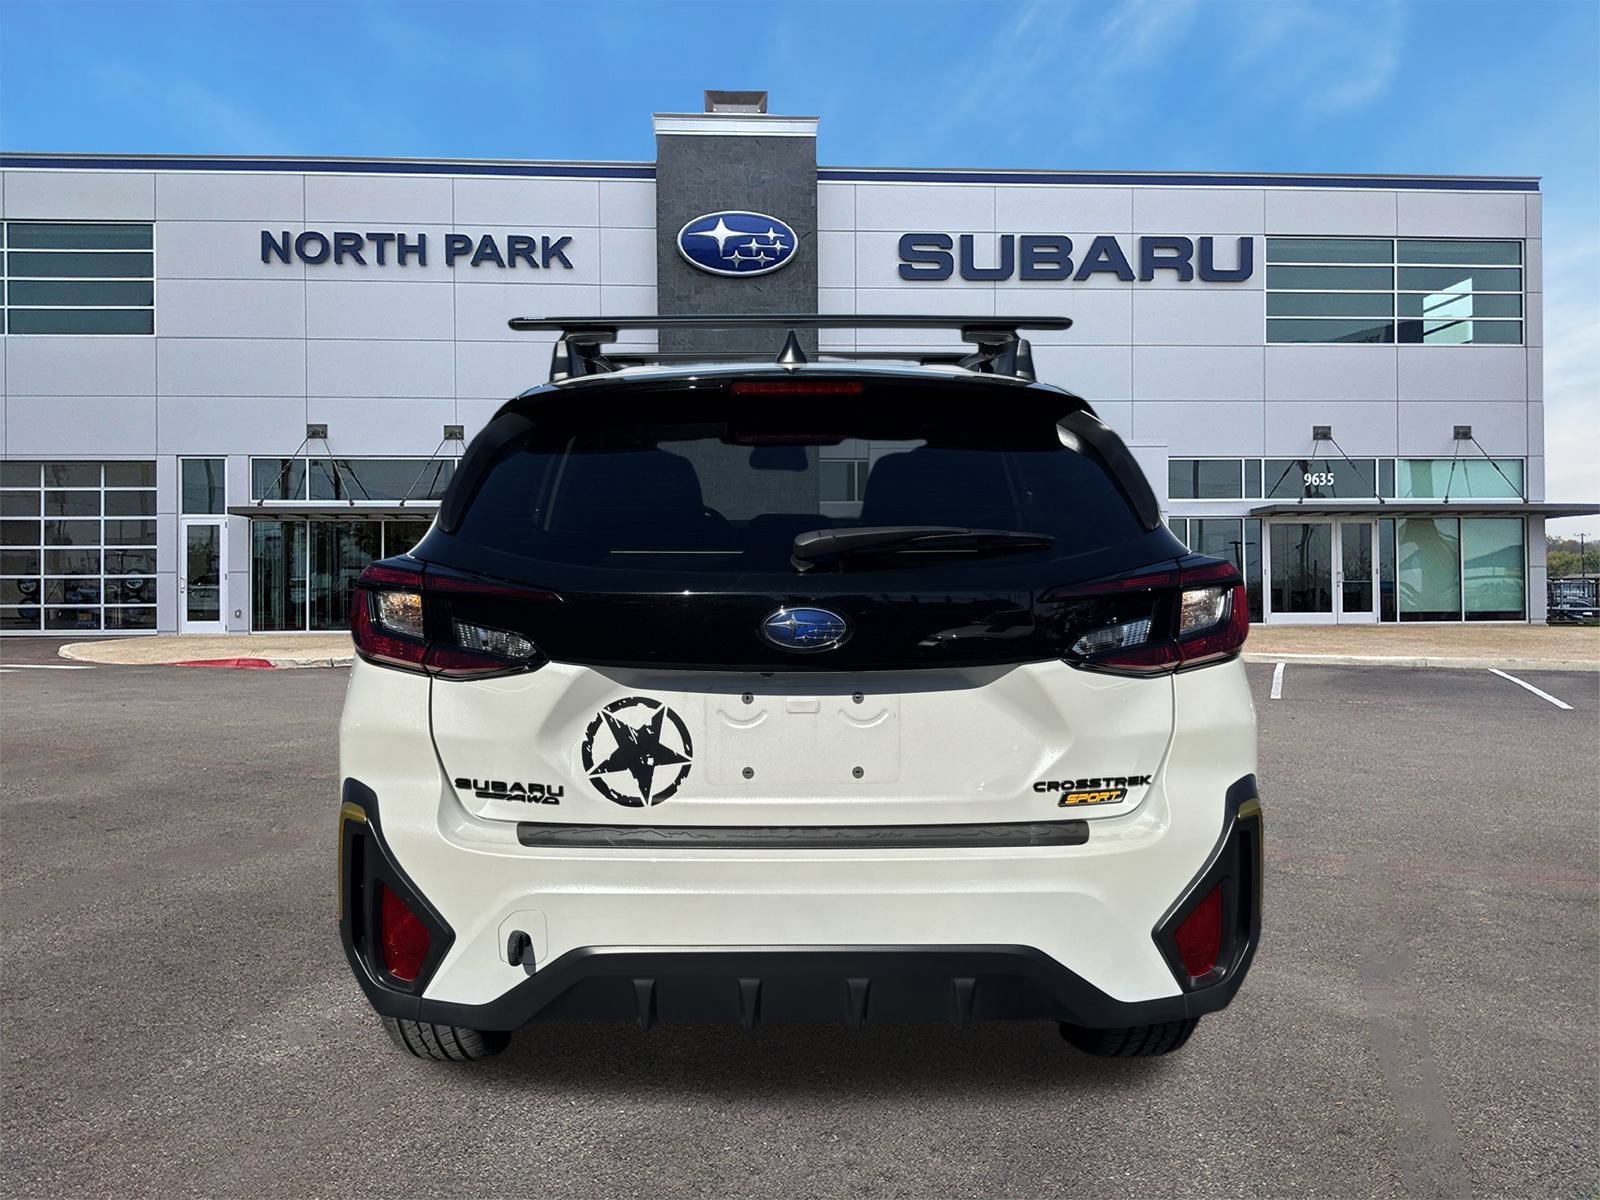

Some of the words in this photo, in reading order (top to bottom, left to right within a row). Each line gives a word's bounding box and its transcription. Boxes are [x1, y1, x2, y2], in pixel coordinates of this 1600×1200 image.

[260, 230, 427, 266] NORTH
[445, 233, 574, 269] PARK
[898, 232, 1254, 282] SUBARU
[1303, 472, 1335, 486] 9635
[454, 777, 564, 797] SUBARU
[1033, 775, 1152, 792] CROSSTREK
[505, 793, 560, 805] AWD
[1064, 791, 1121, 804] SPORT
